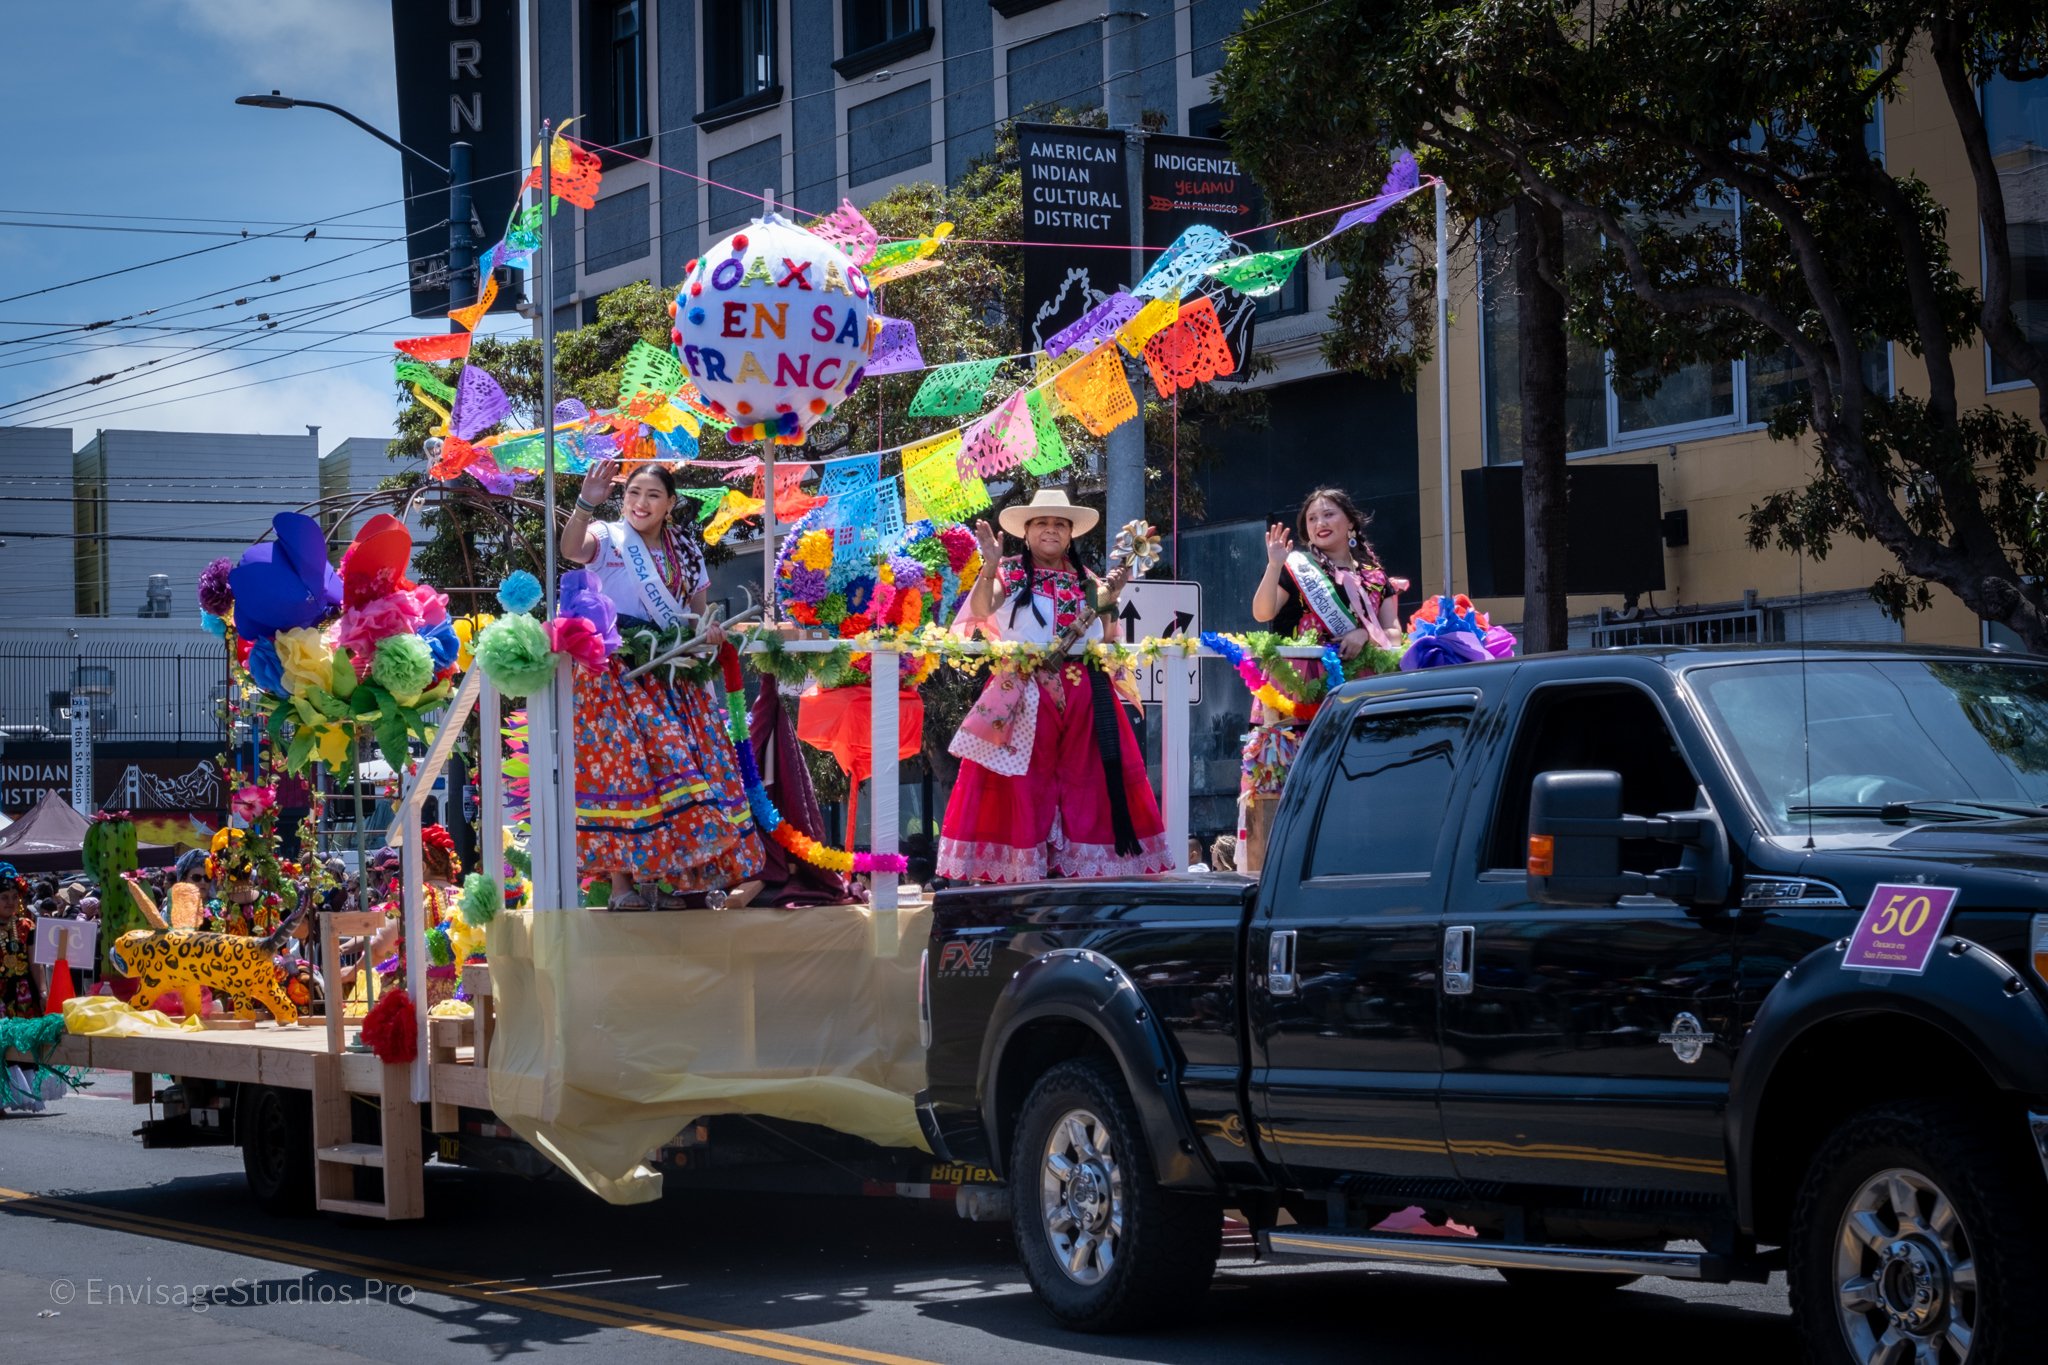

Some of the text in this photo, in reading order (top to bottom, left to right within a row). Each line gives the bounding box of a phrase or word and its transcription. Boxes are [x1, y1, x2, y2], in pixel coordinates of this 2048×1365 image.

[1030, 142, 1117, 163] AMERICAN
[1032, 164, 1090, 184] INDIAN
[1033, 186, 1122, 209] CULTURAL
[1175, 179, 1235, 196] YELAMU
[1173, 200, 1238, 214] SAN FRANCISCO
[1034, 209, 1111, 230] DISTRICT
[720, 301, 789, 339] EN
[627, 545, 650, 582] DIOSA
[1155, 669, 1197, 685] OY
[1, 765, 68, 782] INDIAN
[75, 726, 84, 804] 16th St Mission
[1871, 894, 1931, 937] 50
[939, 938, 994, 970] FX4
[1864, 950, 1876, 959] San
[930, 1163, 999, 1185] BigTex
